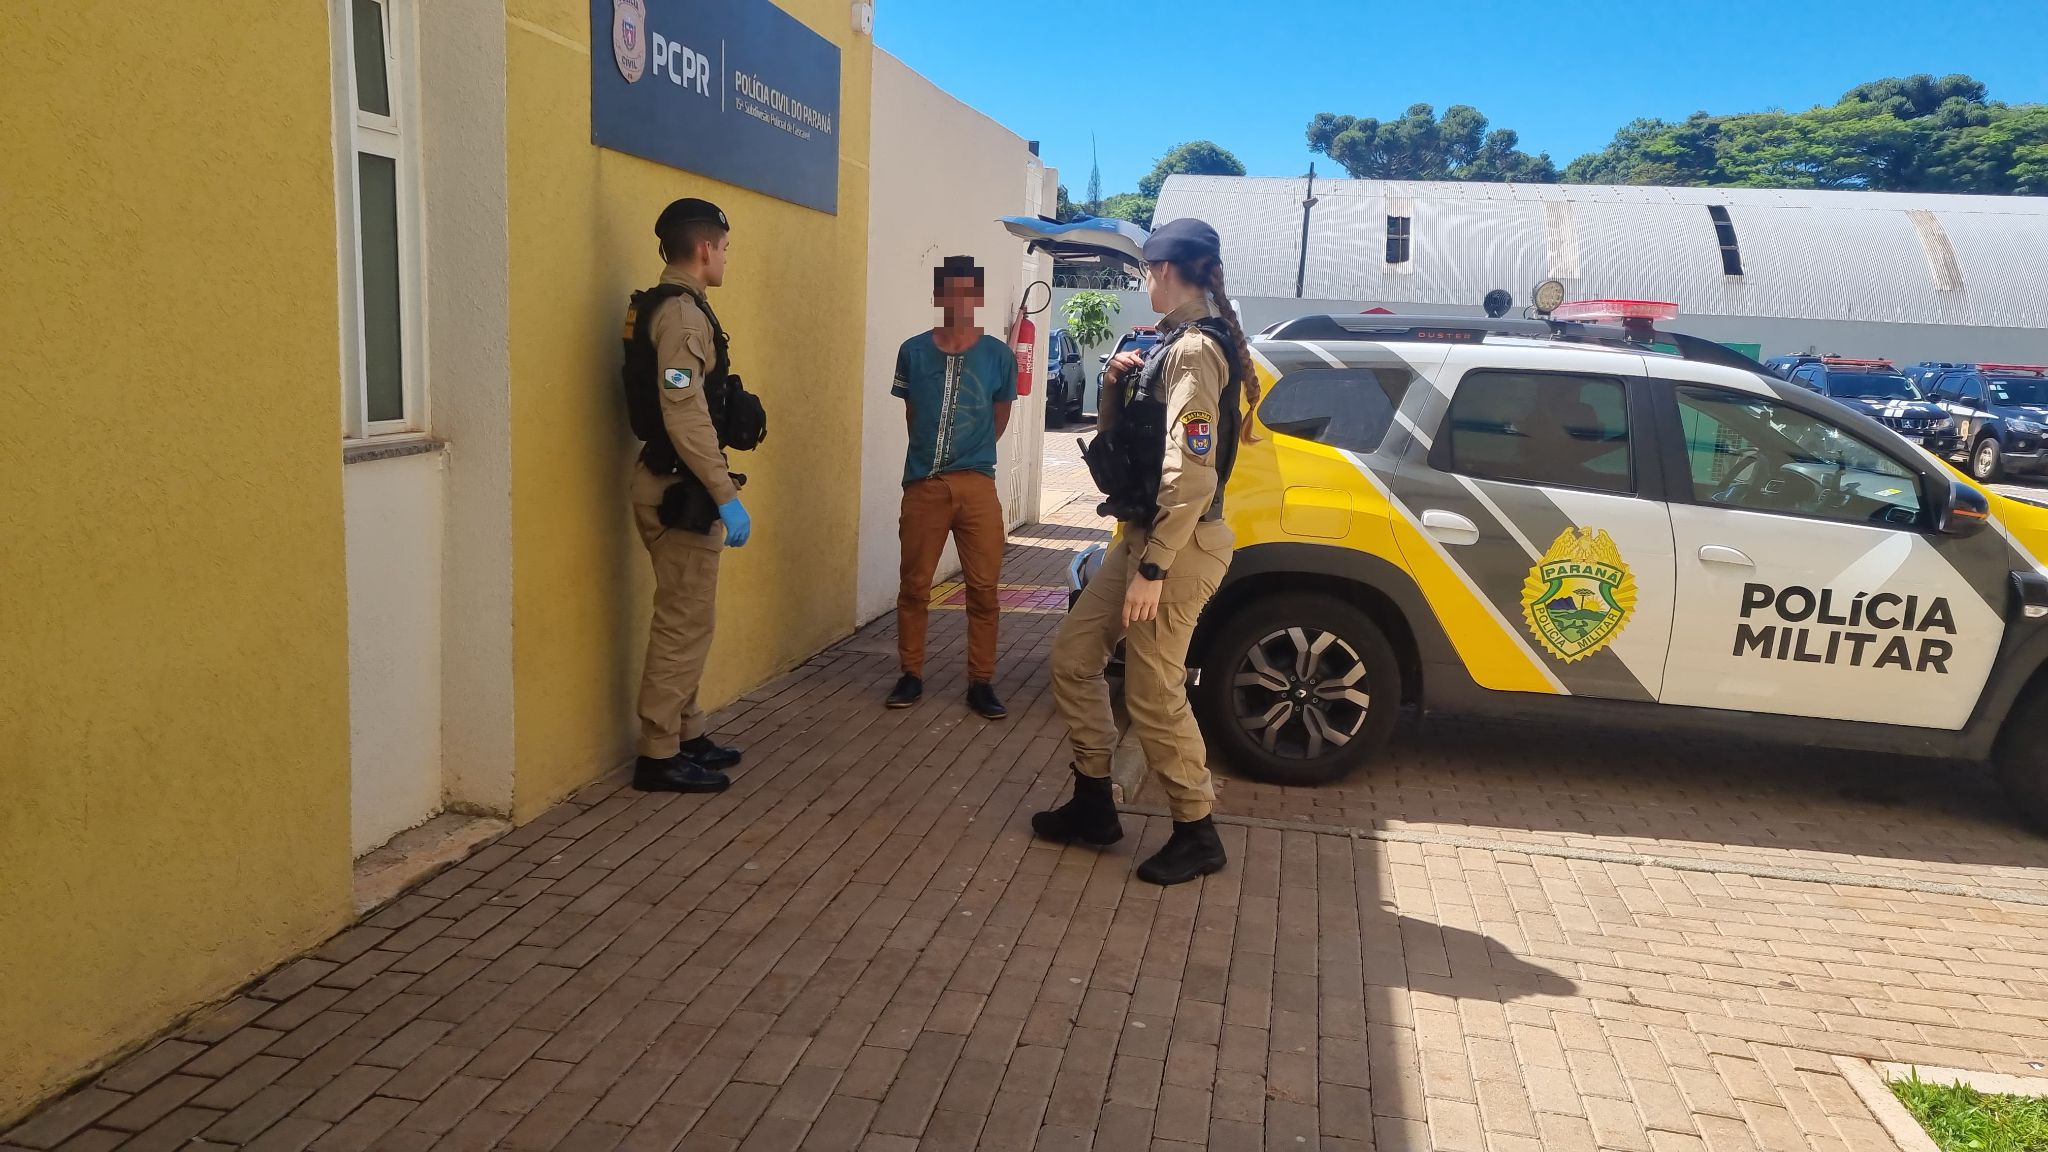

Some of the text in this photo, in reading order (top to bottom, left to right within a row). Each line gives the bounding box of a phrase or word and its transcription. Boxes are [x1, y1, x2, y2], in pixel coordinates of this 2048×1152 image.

[621, 55, 638, 69] CIVIL
[652, 32, 710, 97] PCPR
[735, 70, 832, 135] POLÍCIA CIVIL DO PARANÁ
[1544, 564, 1619, 584] PARANÁ
[1576, 613, 1618, 649] MILITAR
[1739, 582, 1958, 634] POLÍCIA
[1732, 623, 1954, 674] MILITAR
